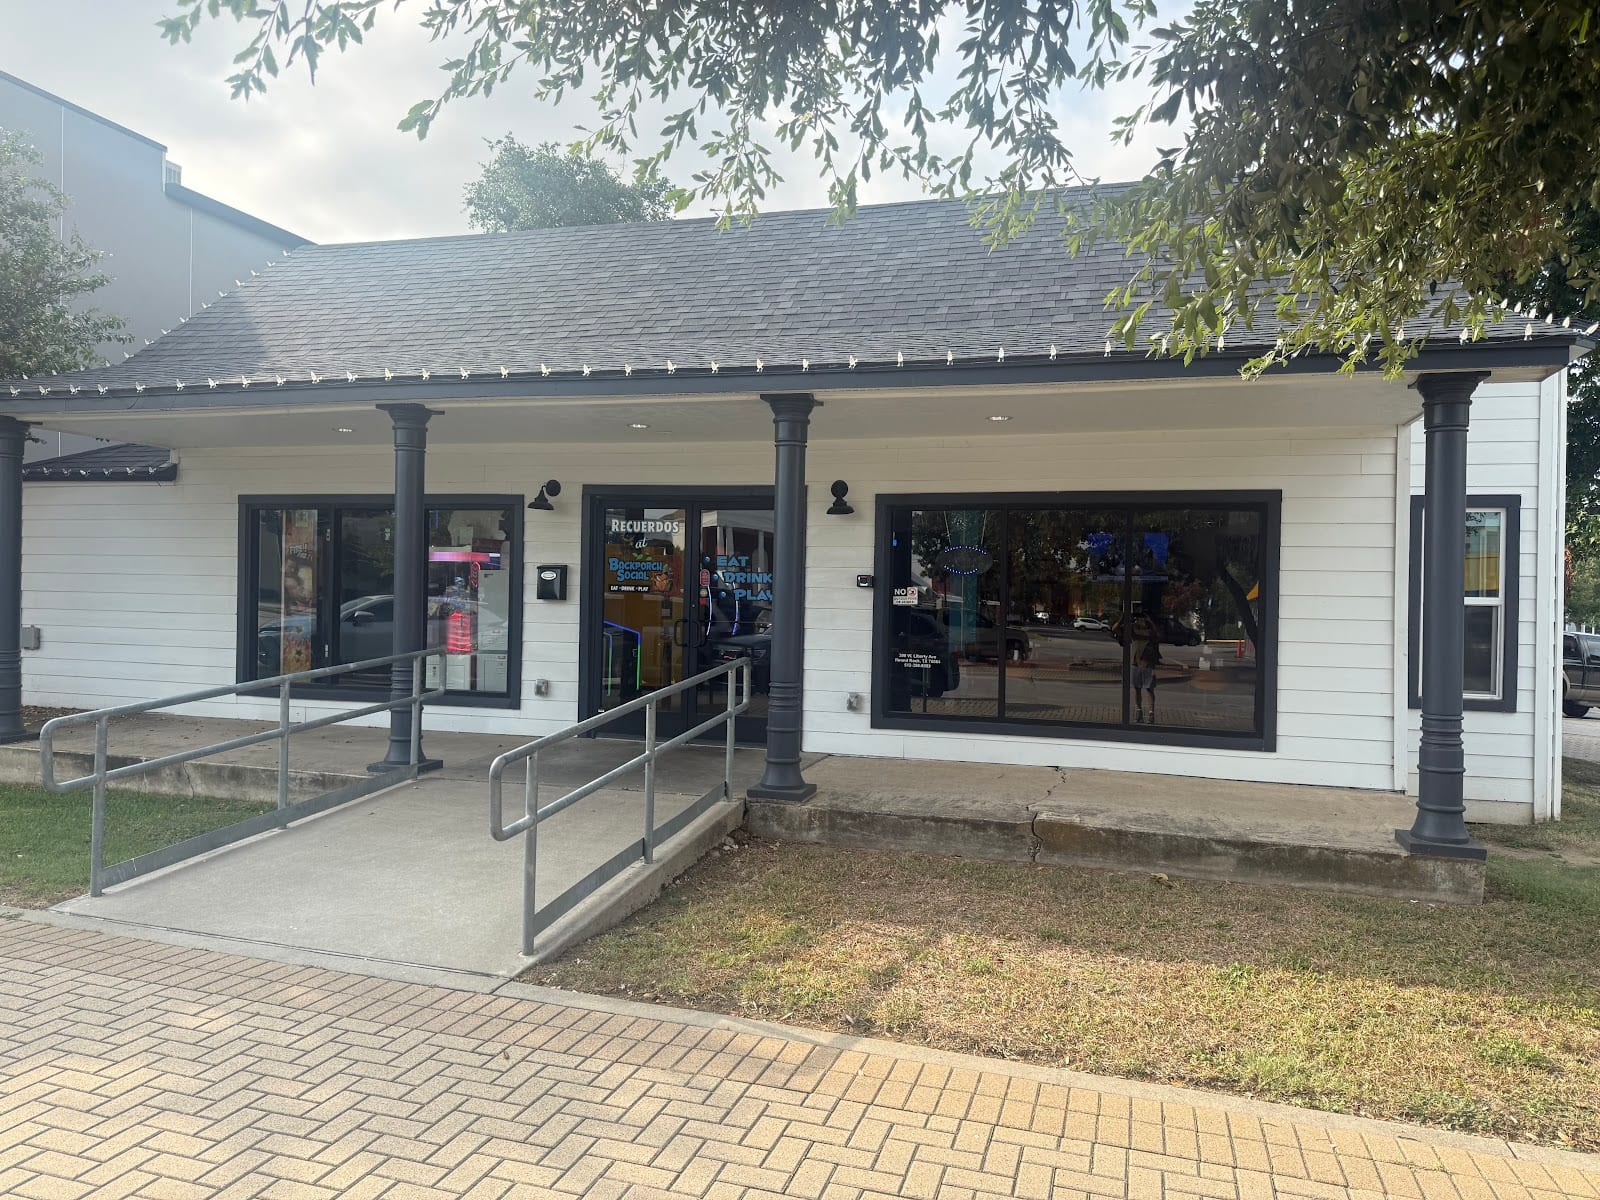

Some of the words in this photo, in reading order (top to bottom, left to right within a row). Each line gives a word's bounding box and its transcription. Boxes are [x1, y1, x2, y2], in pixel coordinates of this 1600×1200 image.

[611, 519, 679, 533] RECUERDOS
[635, 536, 648, 549] at
[716, 555, 749, 567] EAT
[617, 570, 649, 581] SOCIAL
[724, 572, 772, 583] DRINK
[894, 588, 906, 596] NO
